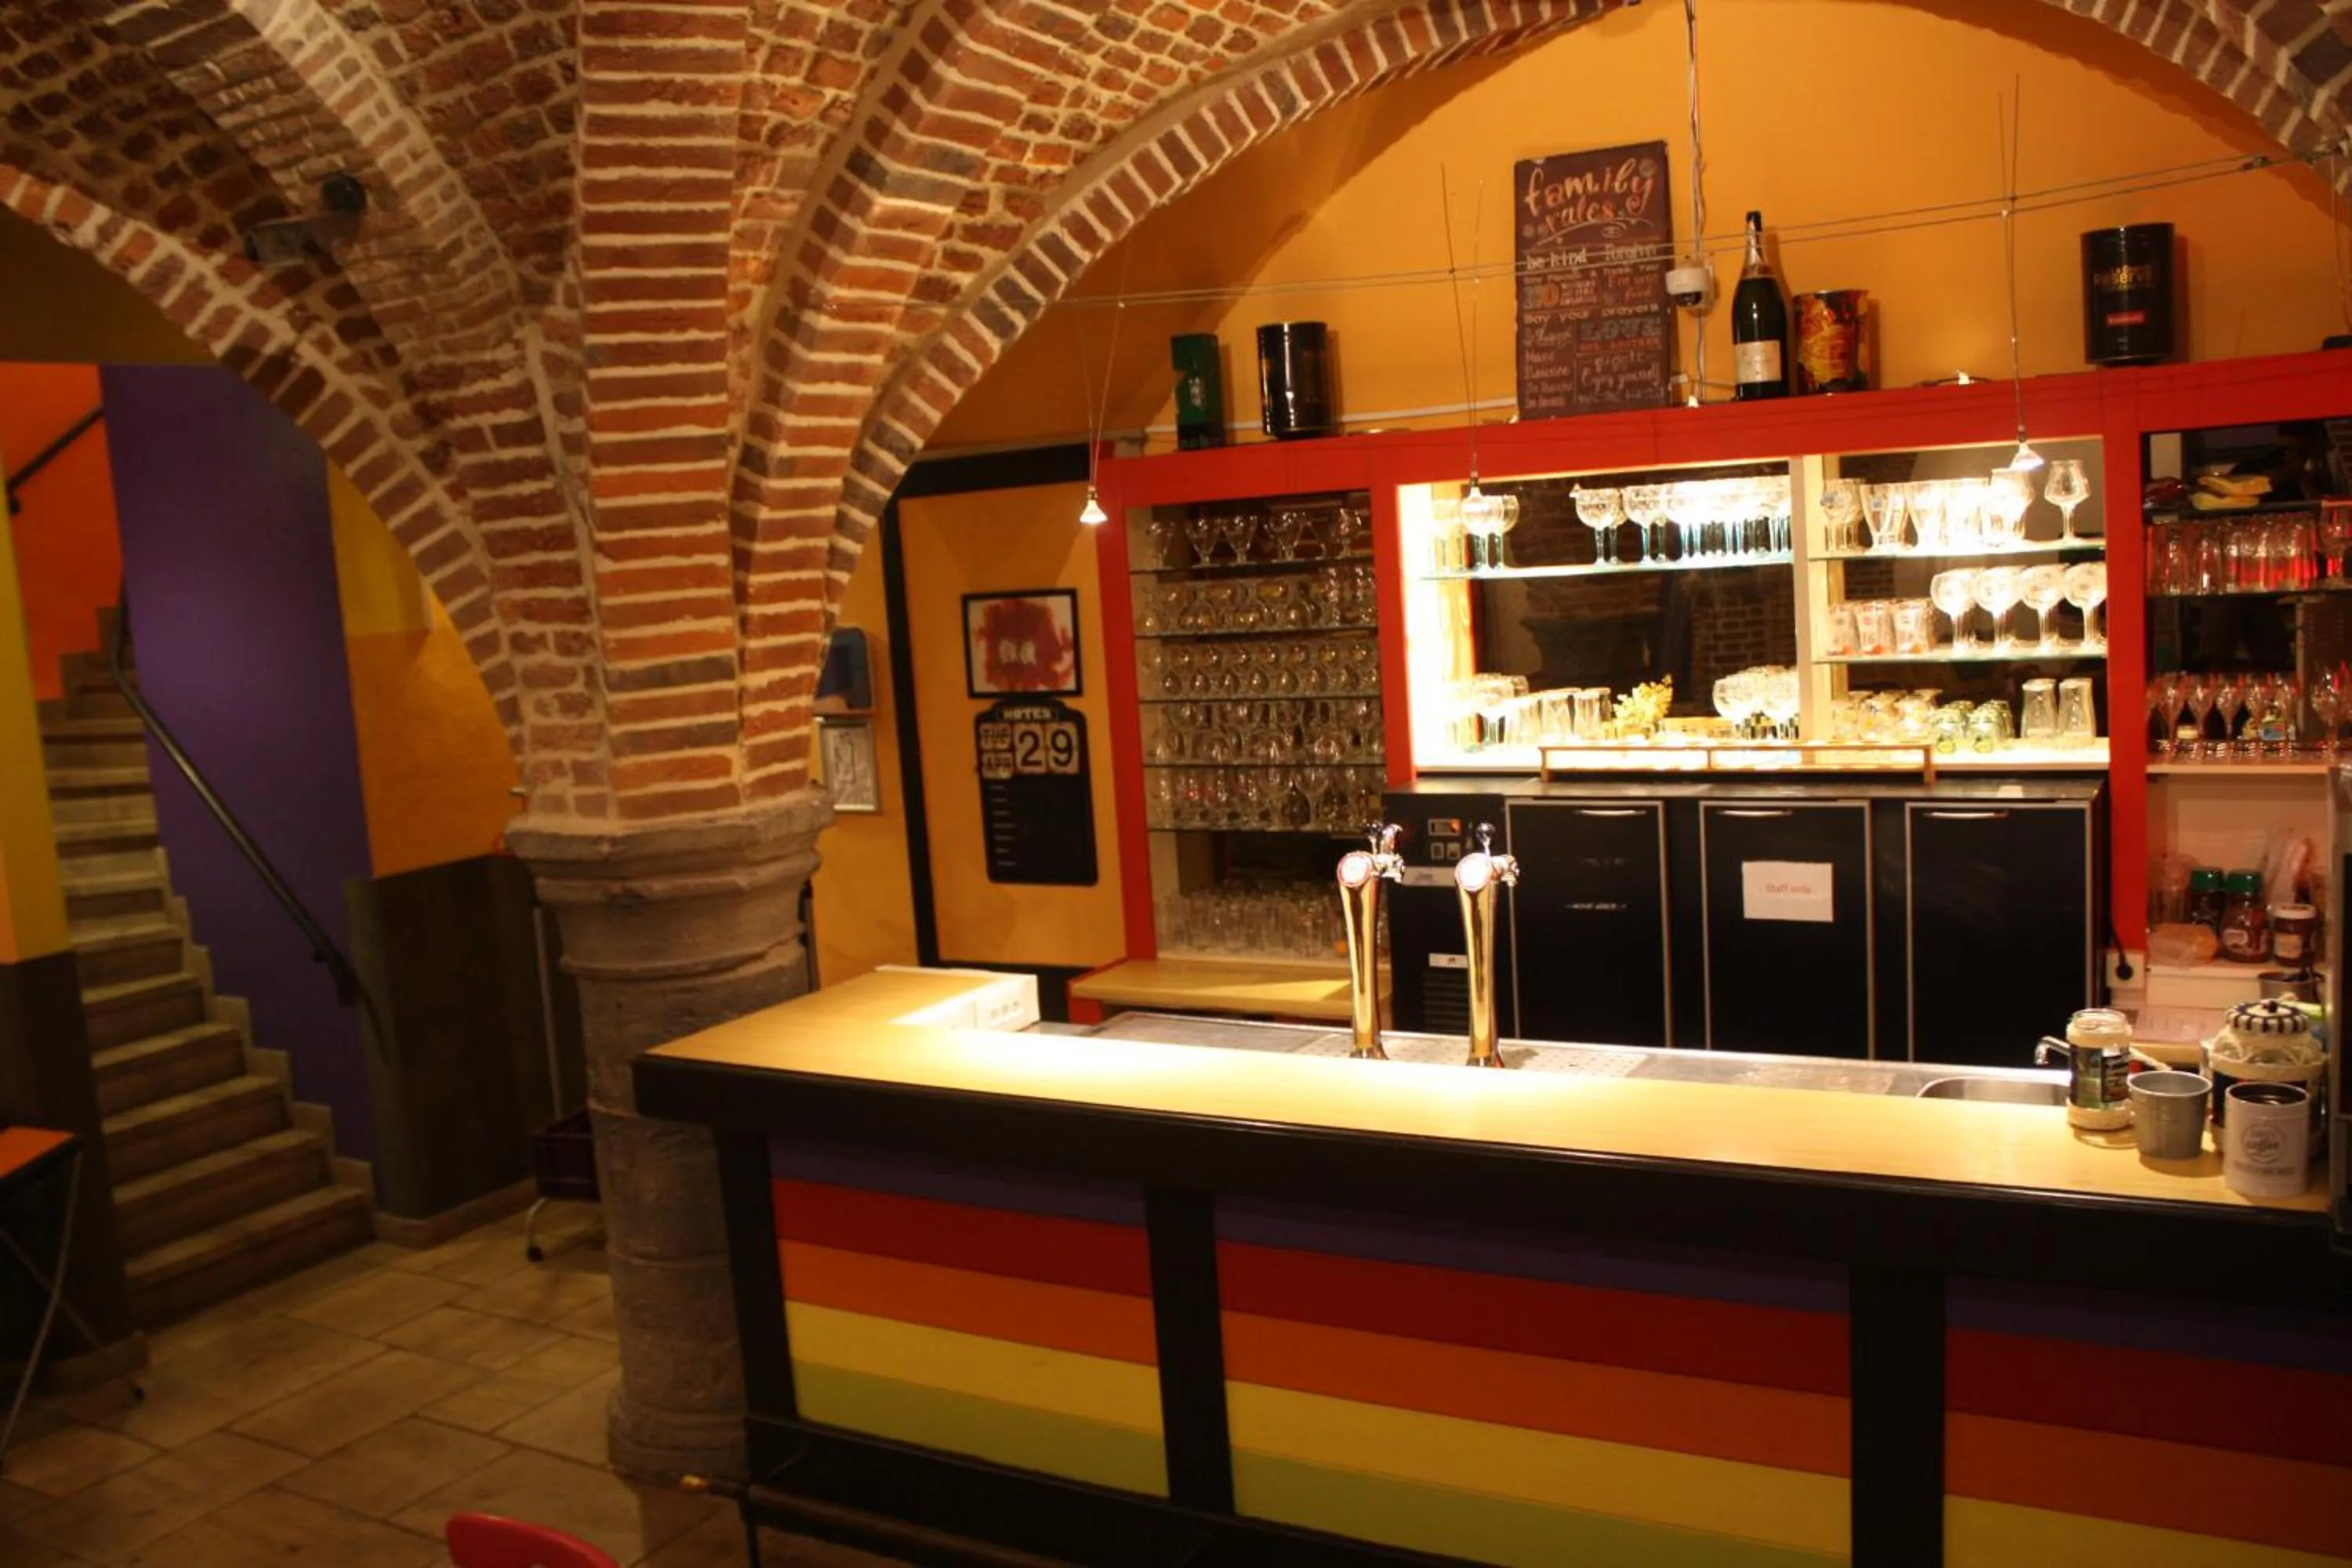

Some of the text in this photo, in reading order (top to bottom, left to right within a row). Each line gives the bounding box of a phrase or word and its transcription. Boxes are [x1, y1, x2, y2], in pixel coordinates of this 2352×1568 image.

[1524, 157, 1654, 217] family
[1003, 706, 1052, 720] NOTES
[1018, 730, 1073, 768] 29
